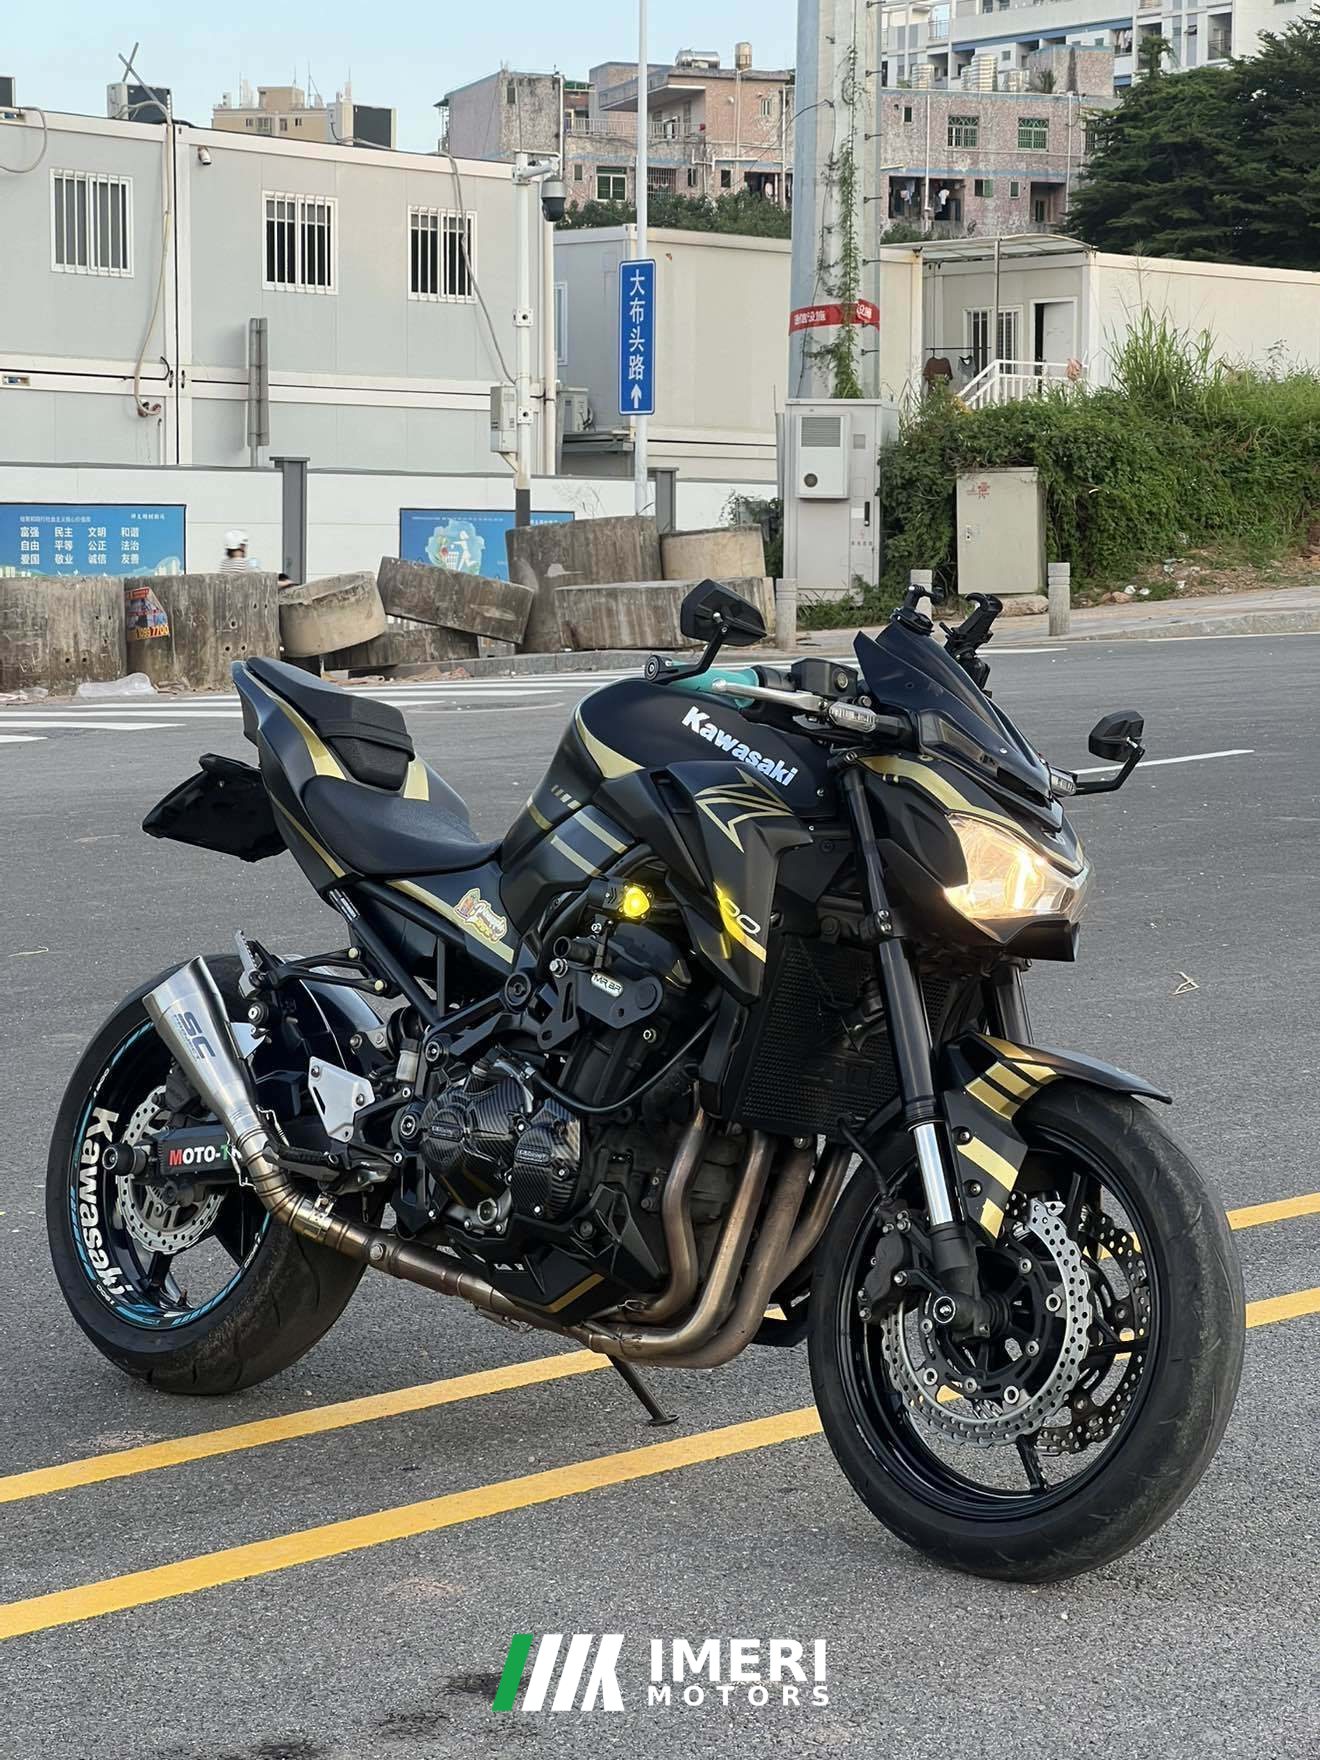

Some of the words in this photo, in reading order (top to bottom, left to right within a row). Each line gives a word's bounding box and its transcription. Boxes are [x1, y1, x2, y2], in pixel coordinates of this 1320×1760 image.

[628, 269, 646, 381] 大布头路
[20, 526, 40, 538] 富强
[54, 526, 73, 538] 民主
[87, 526, 107, 538] 文明
[121, 526, 140, 538] 和谐
[20, 540, 40, 551] 自由
[54, 540, 73, 551] 平等
[87, 540, 107, 551] 公正
[121, 540, 140, 551] 法治
[20, 553, 40, 565] 爱国
[54, 553, 73, 565] 敬业
[87, 553, 107, 565] 诚信
[121, 553, 140, 565] 友善
[681, 705, 799, 787] Kawasaki
[177, 1011, 216, 1059] SC
[79, 1106, 134, 1296] Kawasaki
